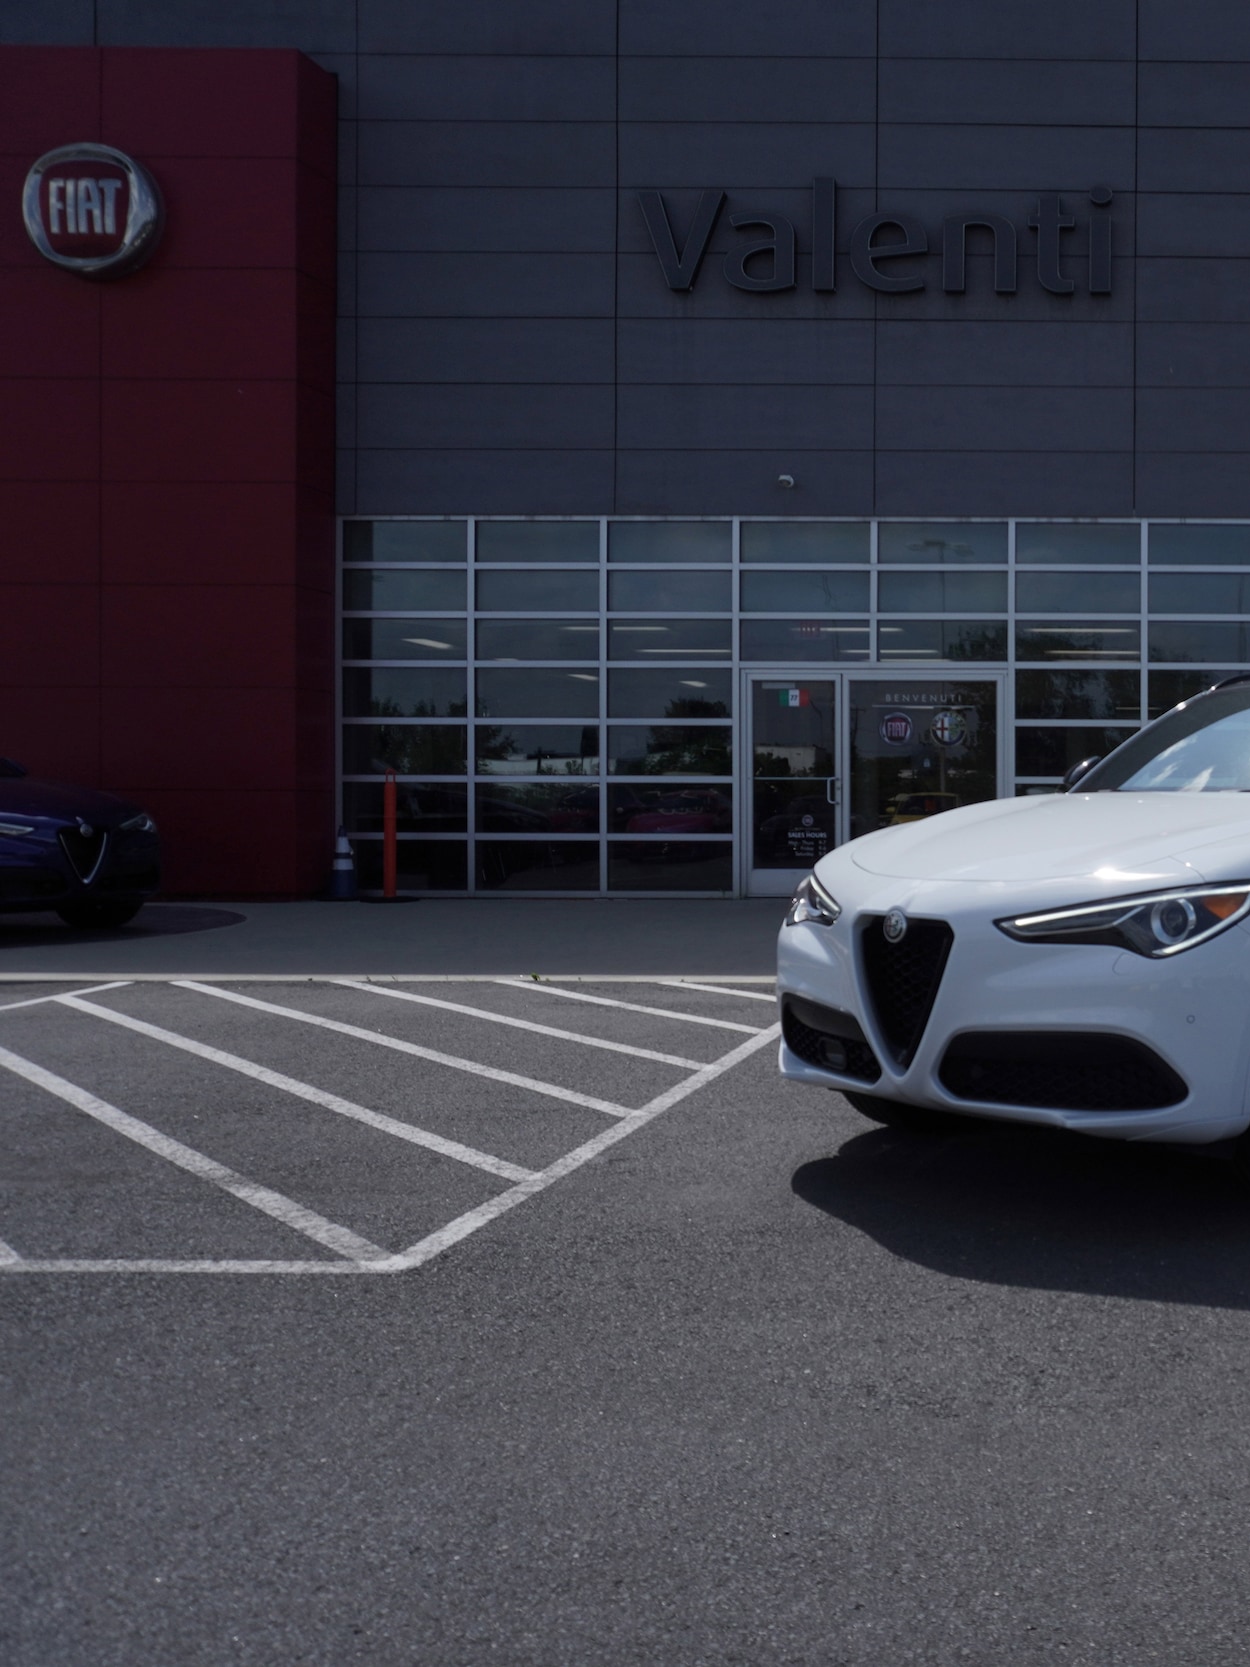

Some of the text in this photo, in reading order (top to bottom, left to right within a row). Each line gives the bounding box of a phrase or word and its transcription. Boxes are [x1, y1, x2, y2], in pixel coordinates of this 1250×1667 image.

[48, 177, 122, 235] FIAT
[637, 176, 1115, 295] Valenti
[885, 693, 962, 703] BENVENUTI
[887, 721, 907, 738] FIAT
